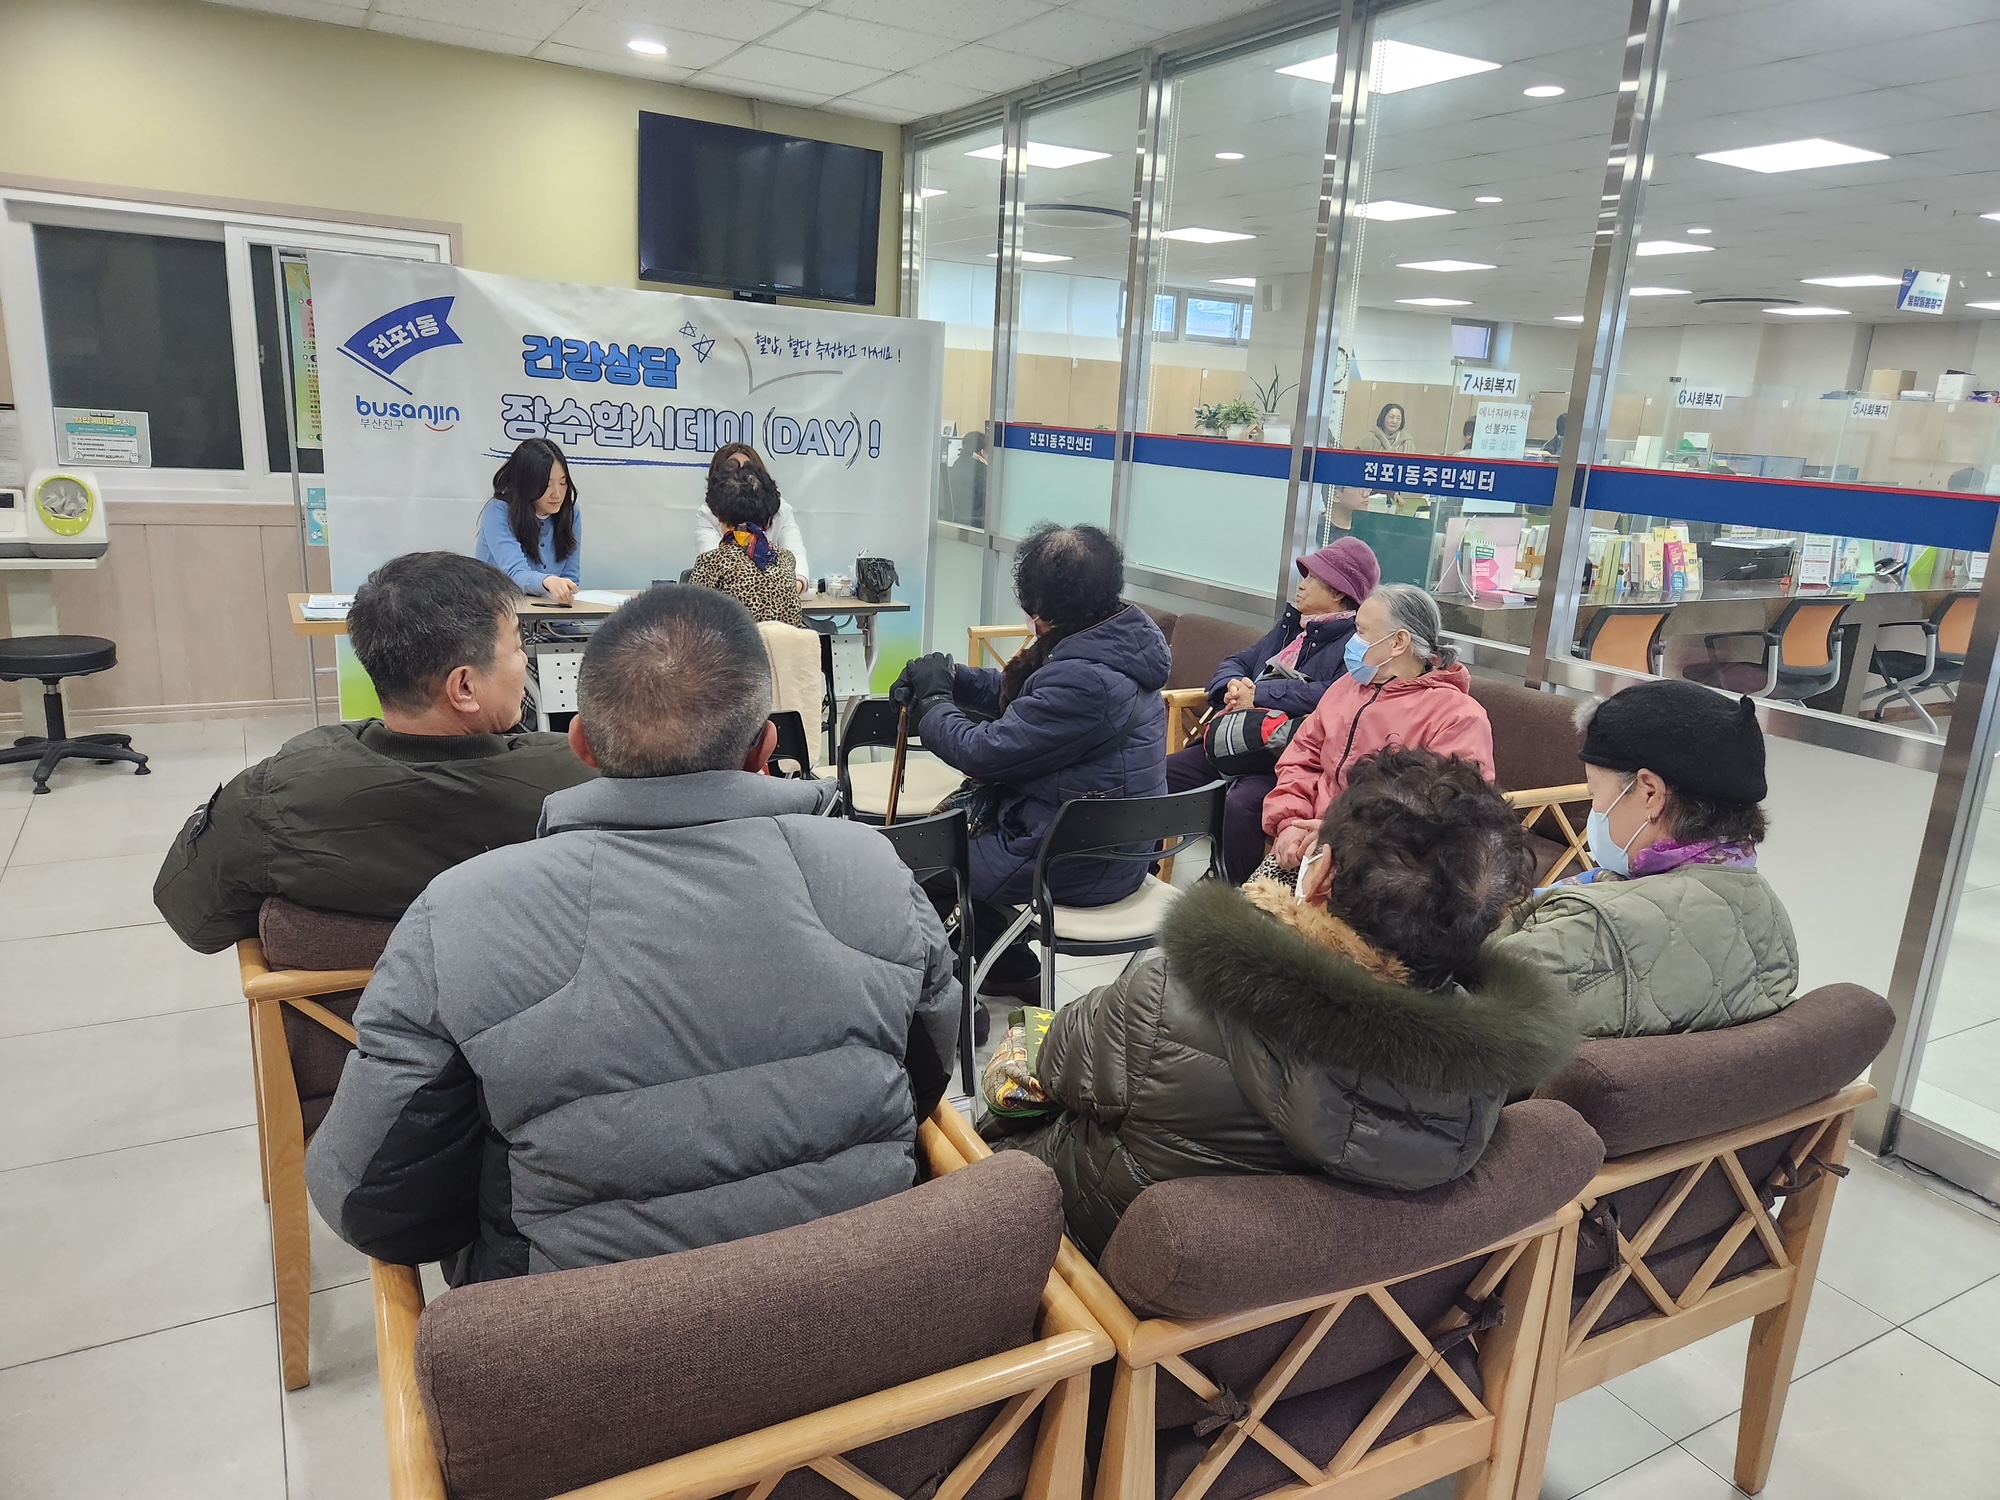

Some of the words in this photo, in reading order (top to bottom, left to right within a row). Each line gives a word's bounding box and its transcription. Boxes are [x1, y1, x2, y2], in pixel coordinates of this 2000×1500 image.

[367, 314, 440, 360] 전포1동
[754, 331, 783, 357] 혈압,
[787, 334, 812, 359] 혈당
[815, 337, 858, 361] 측정하고
[522, 333, 681, 390] 건강상담
[355, 395, 460, 425] busanjin
[1478, 407, 1528, 421] 에너지바우처
[359, 418, 404, 430] 부산진구
[1484, 423, 1517, 435] 선불카드
[1029, 432, 1093, 452] 전포1동주민센터
[1480, 438, 1497, 449] 발급
[1500, 439, 1517, 451] 신청
[1363, 461, 1496, 492] 전포1동주민센터
